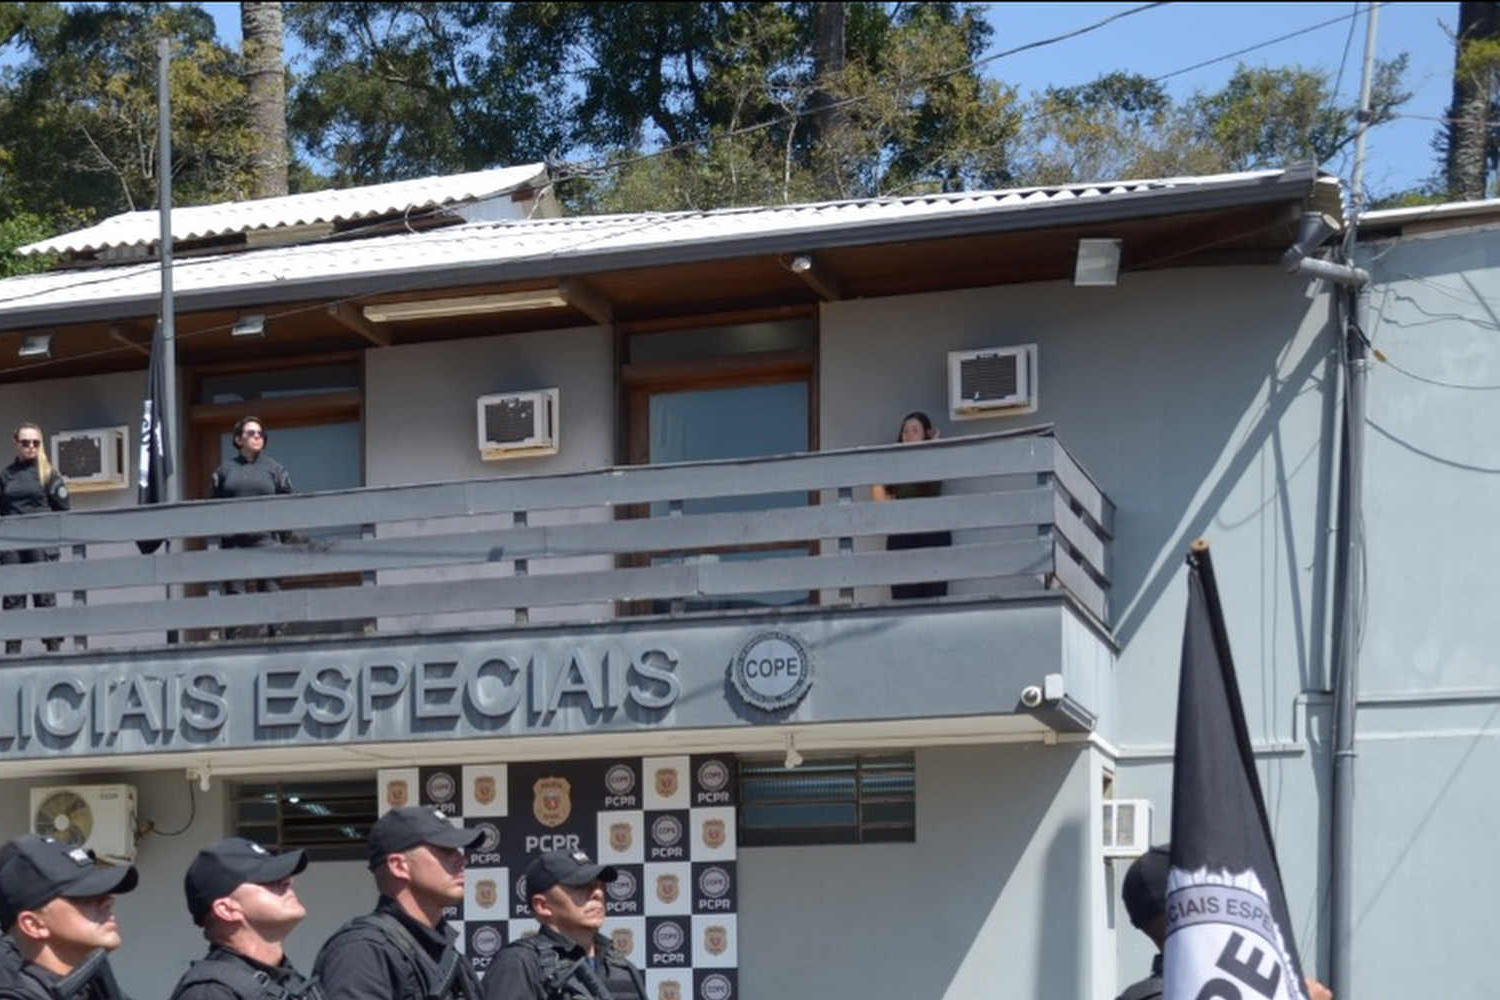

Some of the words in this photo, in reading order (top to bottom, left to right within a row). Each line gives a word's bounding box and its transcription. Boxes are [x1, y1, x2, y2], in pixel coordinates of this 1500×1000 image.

[746, 657, 798, 679] COPE
[256, 649, 681, 729] ESPECIAIS
[605, 795, 636, 807] PCPR
[698, 791, 729, 803] PCPR
[525, 834, 580, 853] PCPR
[470, 853, 500, 864] PCPR
[651, 847, 683, 858] PCPR
[606, 901, 637, 912] PCPR
[699, 898, 731, 910] PCPR
[653, 953, 684, 964] PCPR
